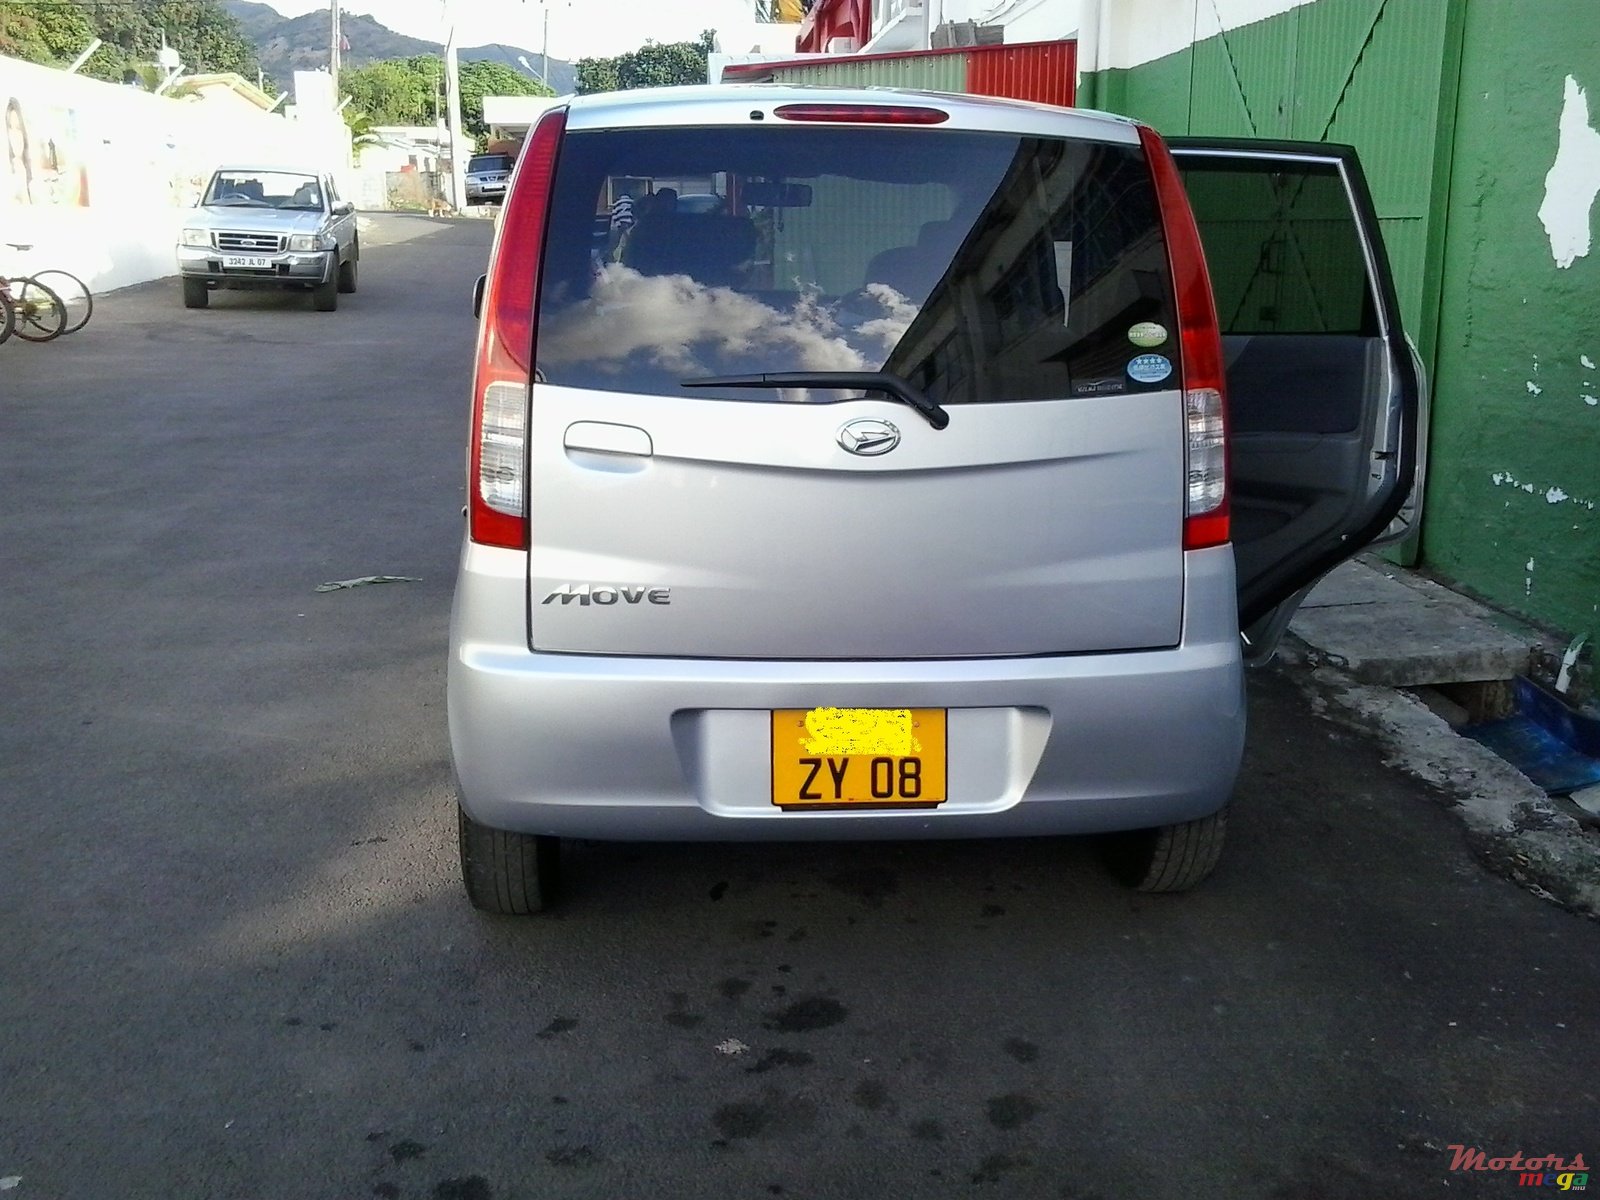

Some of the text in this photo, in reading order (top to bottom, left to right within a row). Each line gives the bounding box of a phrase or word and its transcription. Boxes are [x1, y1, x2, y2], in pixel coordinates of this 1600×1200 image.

[228, 257, 246, 266] 3242
[257, 258, 266, 266] 07
[541, 583, 671, 606] MOVE
[798, 757, 922, 800] ZY 08
